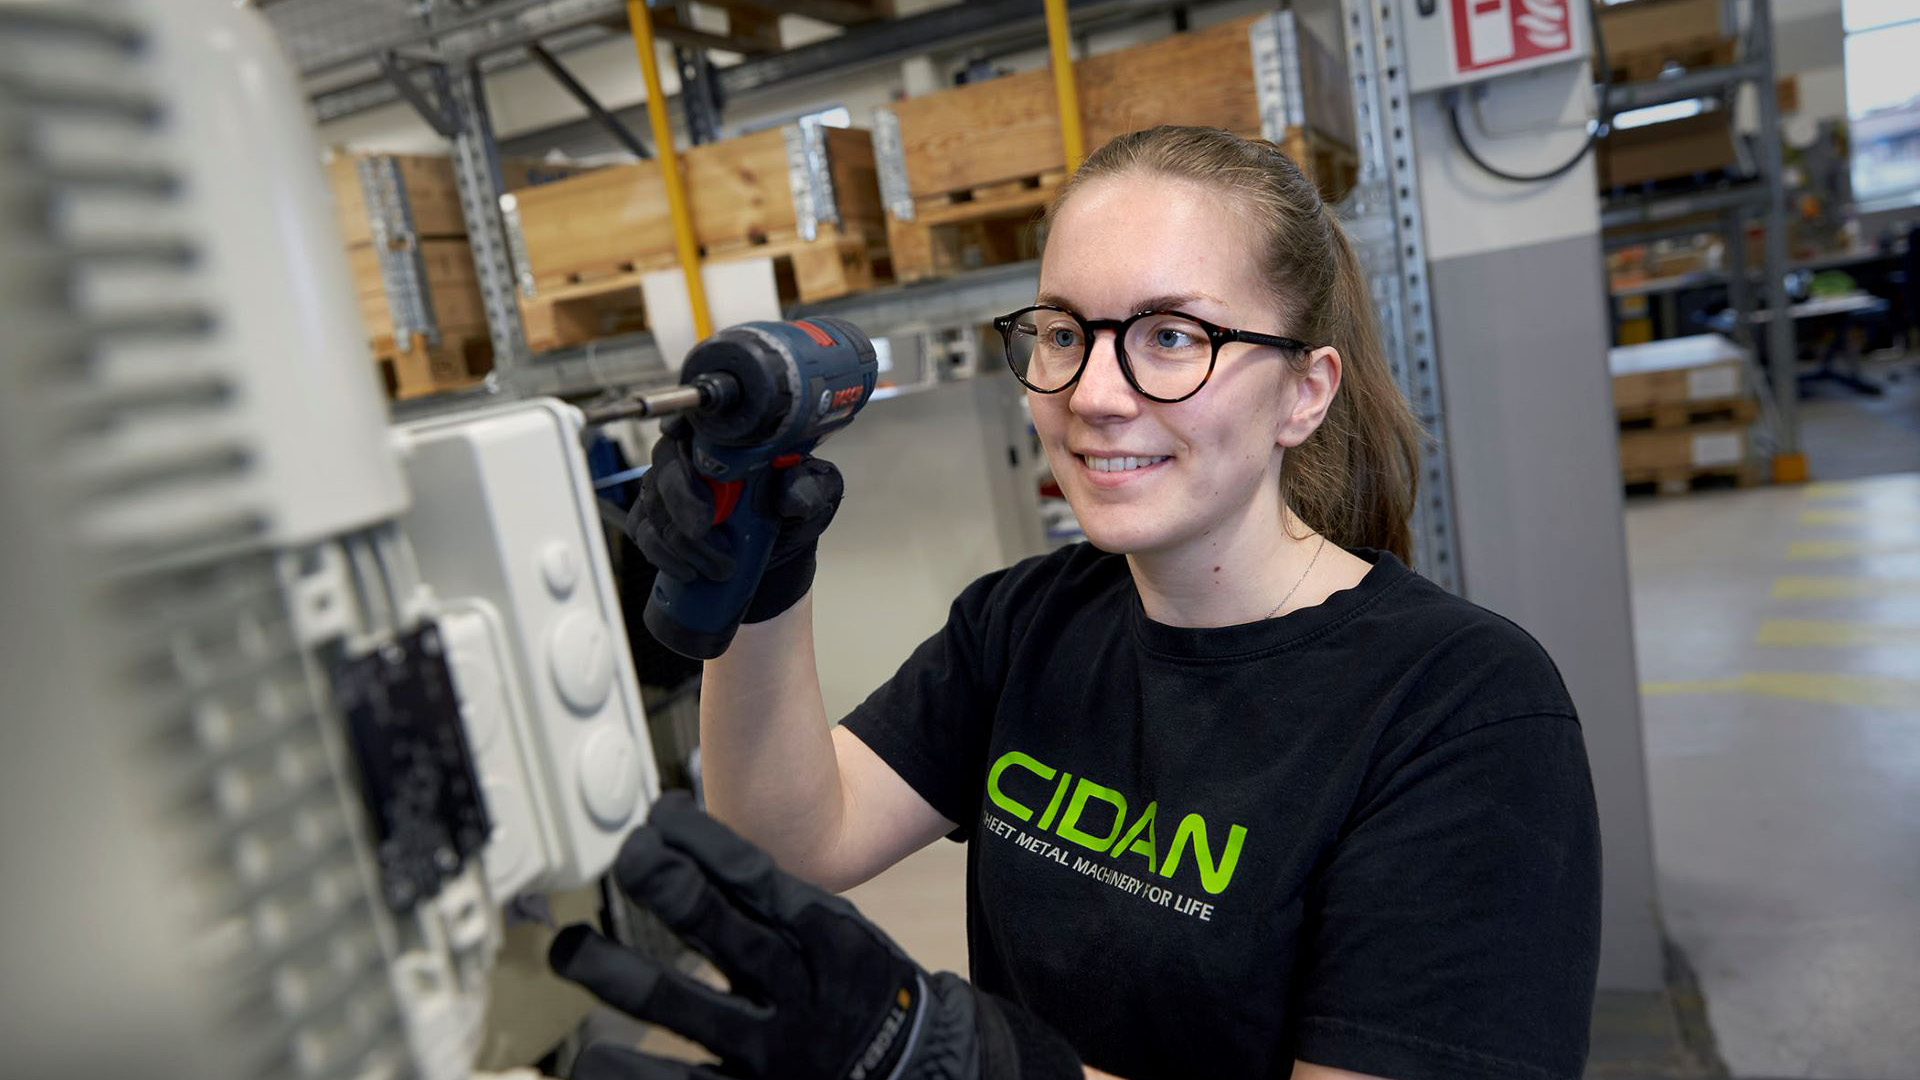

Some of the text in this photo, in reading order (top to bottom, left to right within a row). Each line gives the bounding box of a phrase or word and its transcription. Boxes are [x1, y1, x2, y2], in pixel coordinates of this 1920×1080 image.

[987, 751, 1248, 894] CIDAN
[1015, 832, 1069, 866] METAL
[1072, 857, 1144, 895] MACHINERY
[1142, 883, 1173, 907] FOR
[1174, 894, 1215, 921] LIFE
